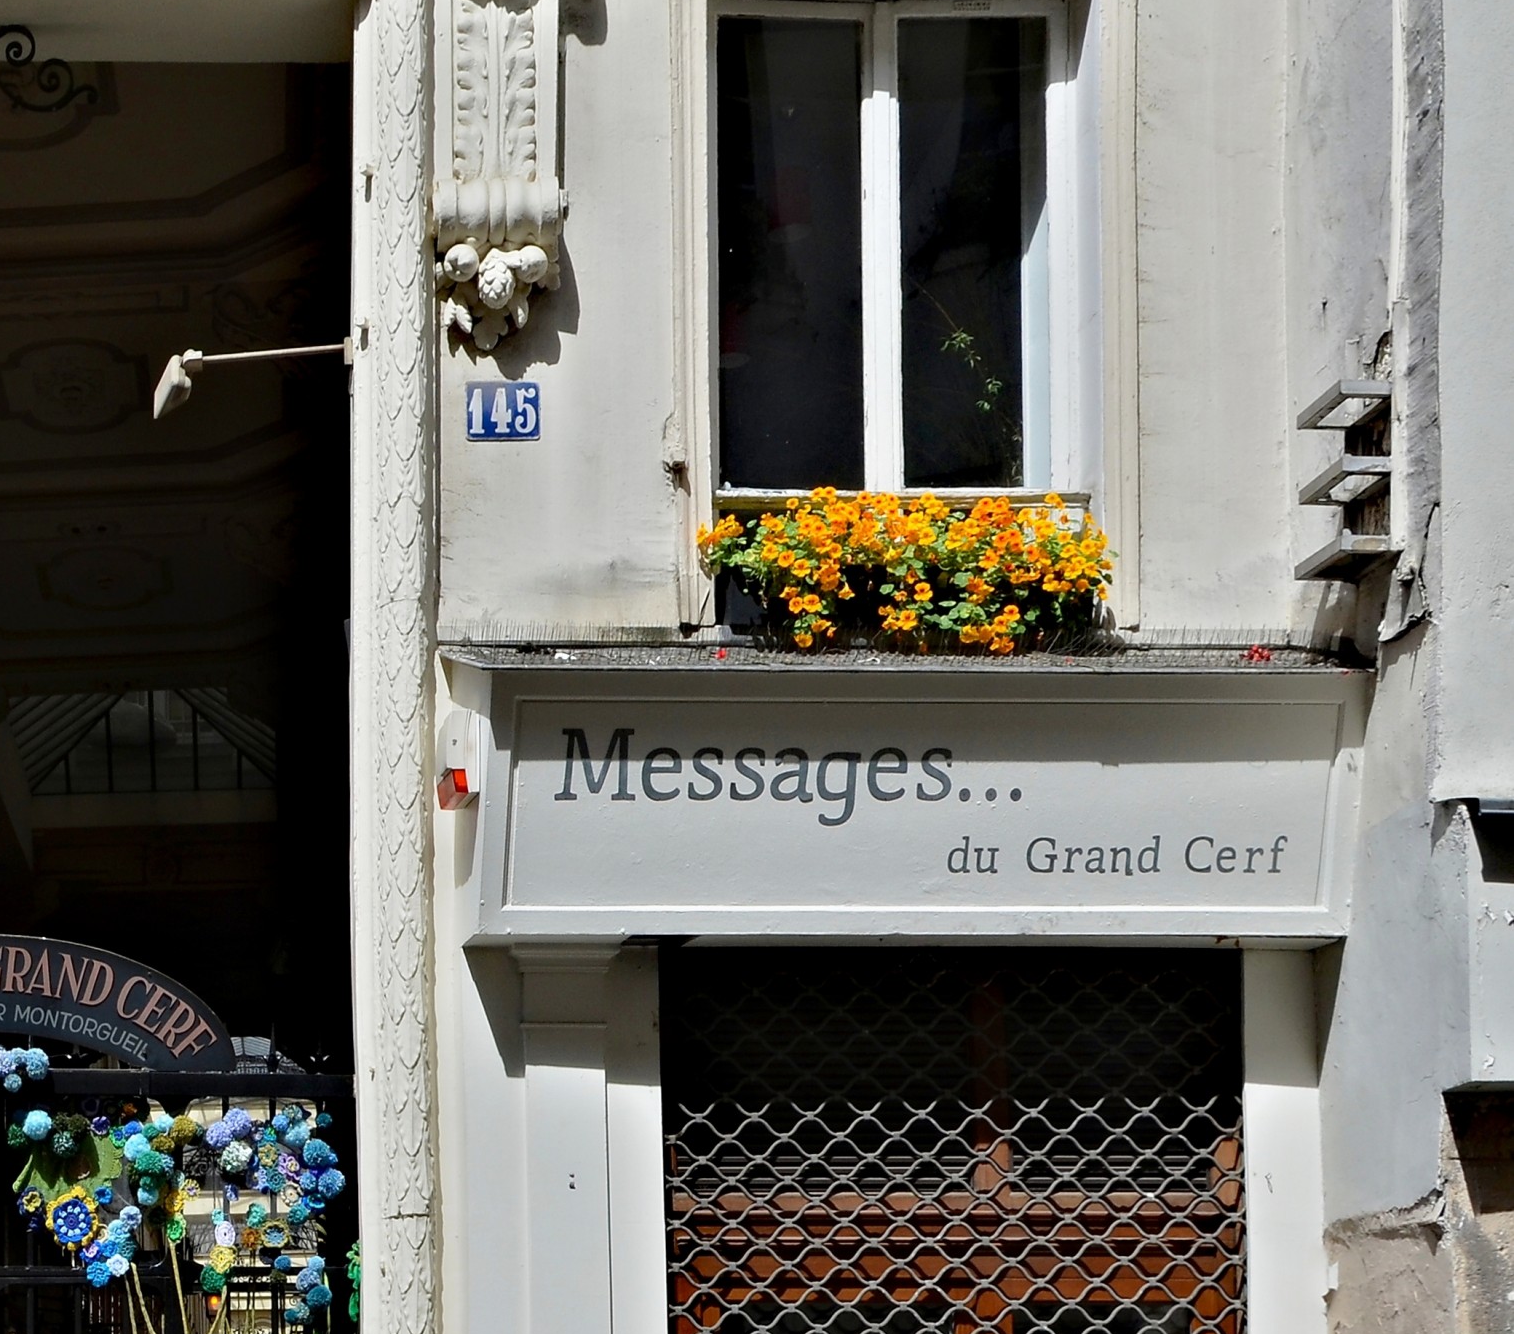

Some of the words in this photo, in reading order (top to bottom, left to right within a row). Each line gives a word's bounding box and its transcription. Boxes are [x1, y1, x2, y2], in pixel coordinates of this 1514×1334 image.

[468, 387, 537, 435] 145
[553, 727, 1024, 827] Messages...
[947, 836, 998, 875] du
[1027, 836, 1161, 877] Grand
[1184, 836, 1288, 875] Cerf
[14, 1005, 150, 1062] MONTORGUEIL
[116, 976, 217, 1060] CERF
